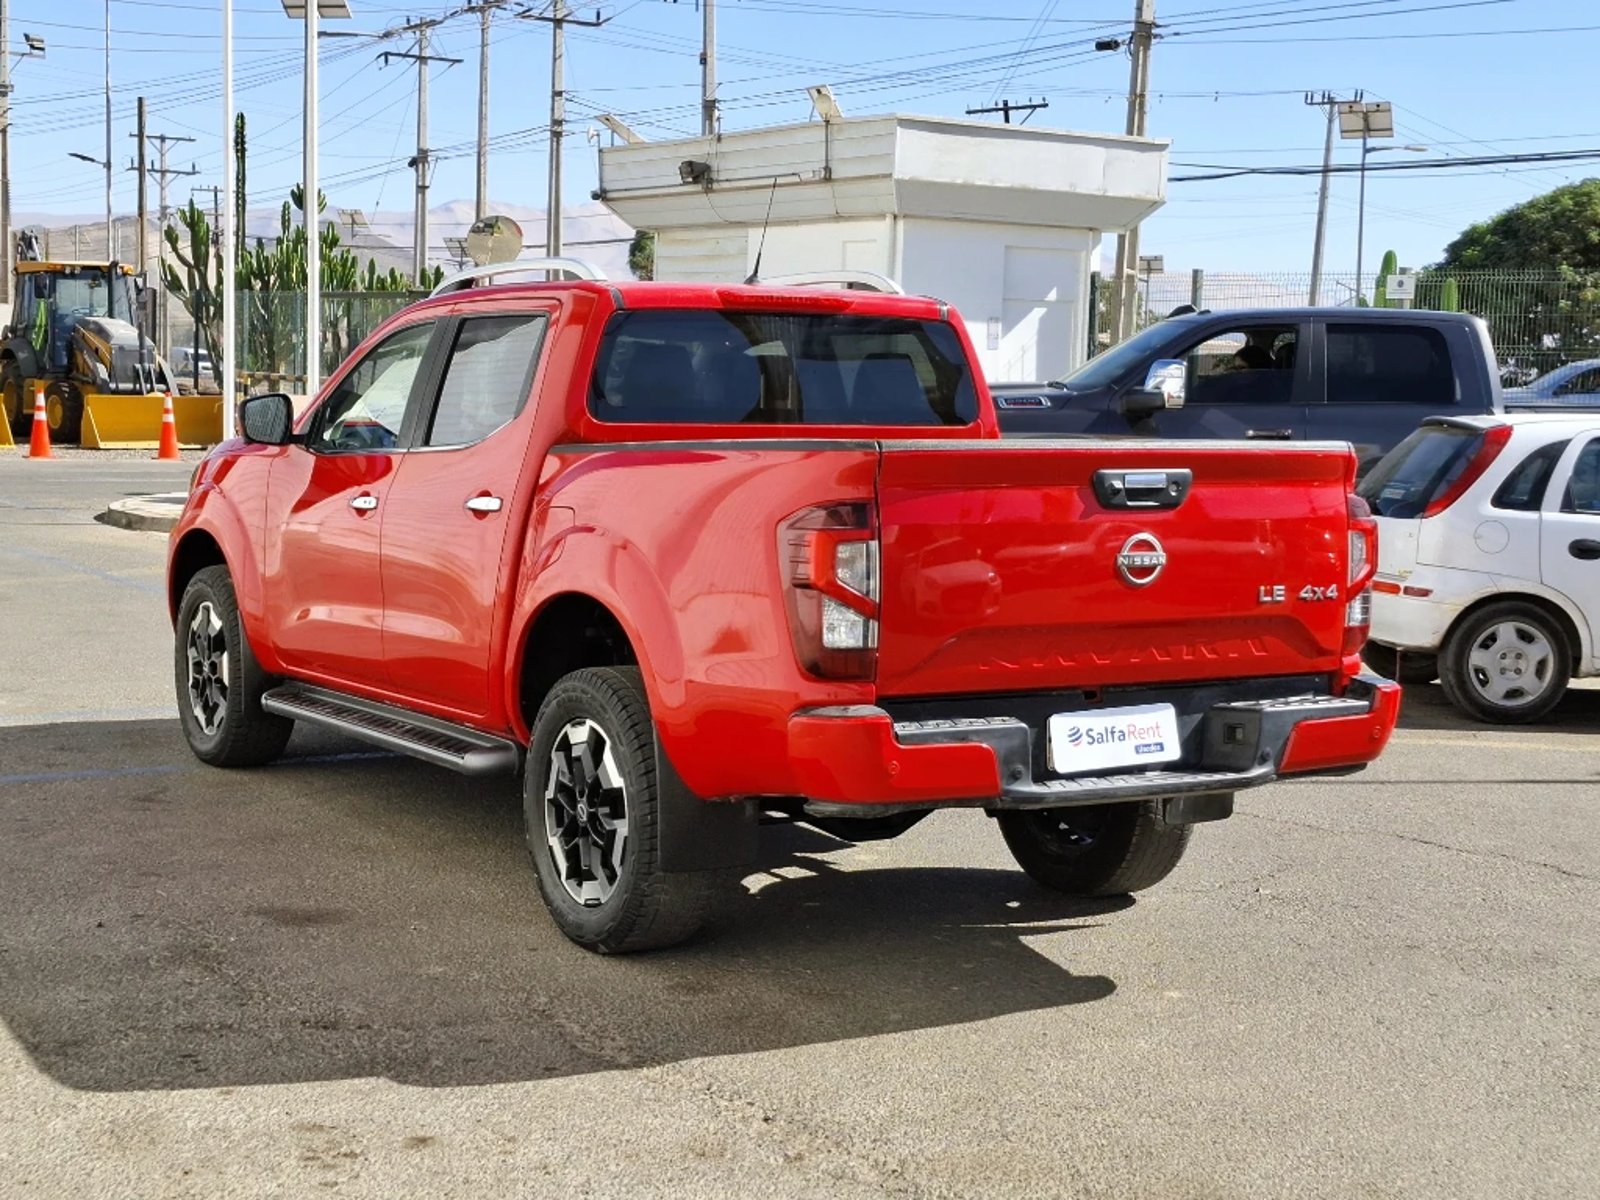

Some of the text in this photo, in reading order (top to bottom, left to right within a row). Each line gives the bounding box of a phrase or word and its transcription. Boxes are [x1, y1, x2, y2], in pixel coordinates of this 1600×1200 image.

[1119, 555, 1165, 566] NISSAN
[1259, 583, 1338, 602] LE 4x4
[1085, 721, 1163, 745] SalfaRent
